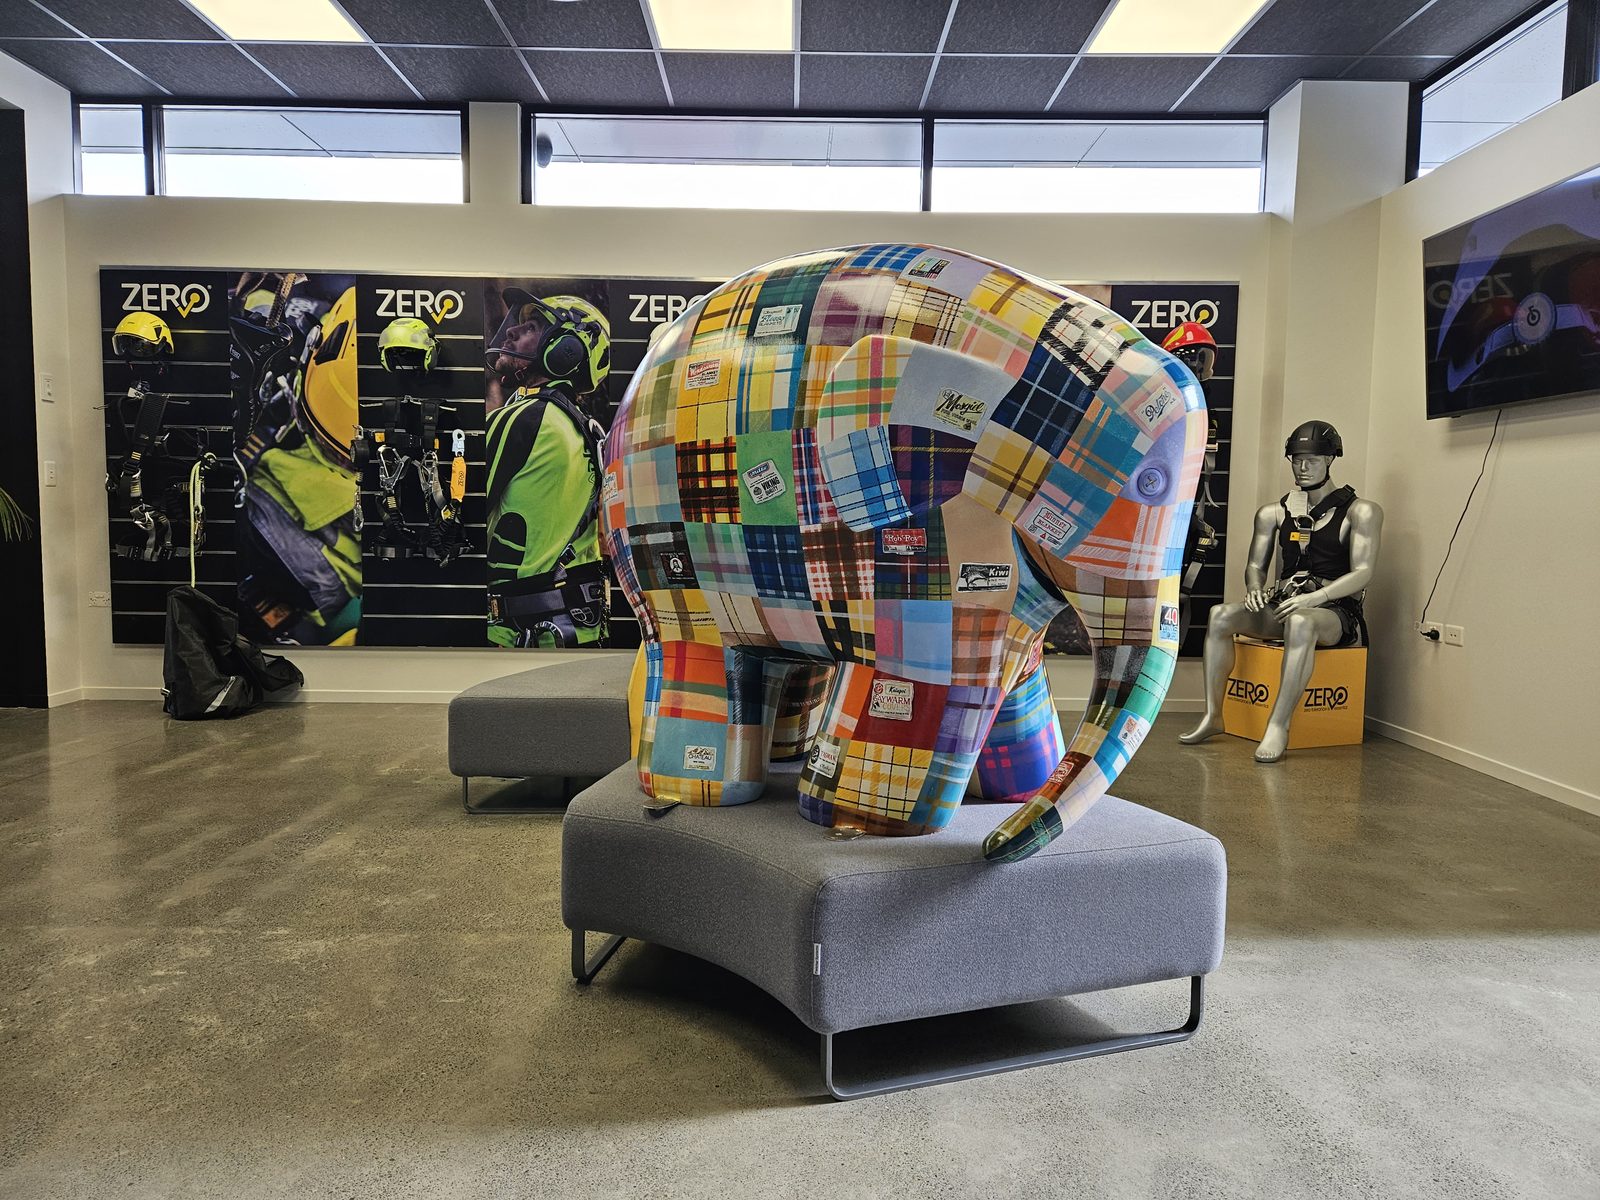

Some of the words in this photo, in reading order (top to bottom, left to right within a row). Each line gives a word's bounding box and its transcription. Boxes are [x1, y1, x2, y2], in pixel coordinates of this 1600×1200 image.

[121, 283, 210, 318] ZERO
[376, 289, 463, 324] ZERO
[1132, 300, 1219, 329] ZERO
[761, 476, 780, 491] VIKING
[989, 566, 1009, 577] Kiwi
[1164, 607, 1178, 625] 40
[1227, 678, 1269, 704] ZERO
[1304, 686, 1348, 709] ZERO
